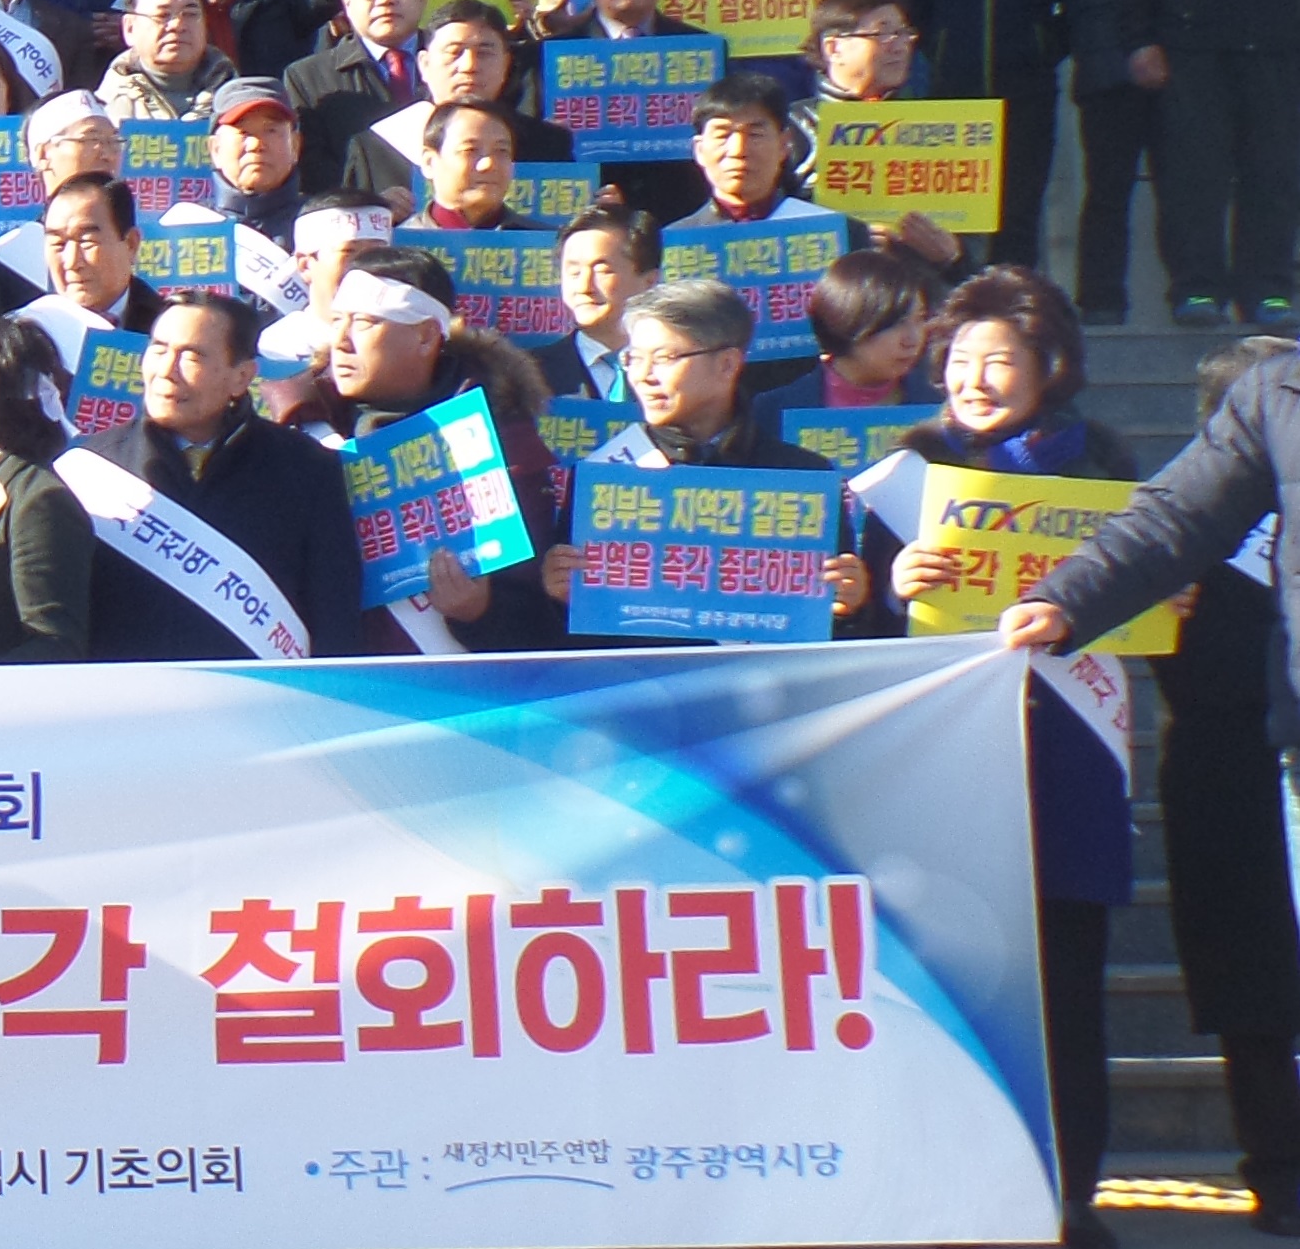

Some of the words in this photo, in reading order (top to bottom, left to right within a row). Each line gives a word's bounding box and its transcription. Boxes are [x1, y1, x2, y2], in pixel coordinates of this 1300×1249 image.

[16, 43, 54, 80] 경유
[557, 56, 606, 89] 정부는
[611, 54, 658, 85] 지역간
[665, 50, 715, 83] 갈등과
[831, 120, 903, 146] KTX
[899, 124, 956, 146] 서대전역
[963, 123, 993, 146] 경유
[826, 161, 875, 195] 즉각
[885, 159, 991, 194] 철회하라!
[592, 483, 665, 530] 정부는
[672, 487, 746, 535] 지역간
[752, 492, 825, 538] 갈등과
[940, 498, 1046, 531] KTX
[215, 570, 273, 627] 경유
[197, 882, 875, 1066] 철회하라!
[64, 1145, 246, 1195] 기초의회
[443, 1139, 611, 1165] 새정치민주연합
[625, 1142, 842, 1181] 광주광역시당
